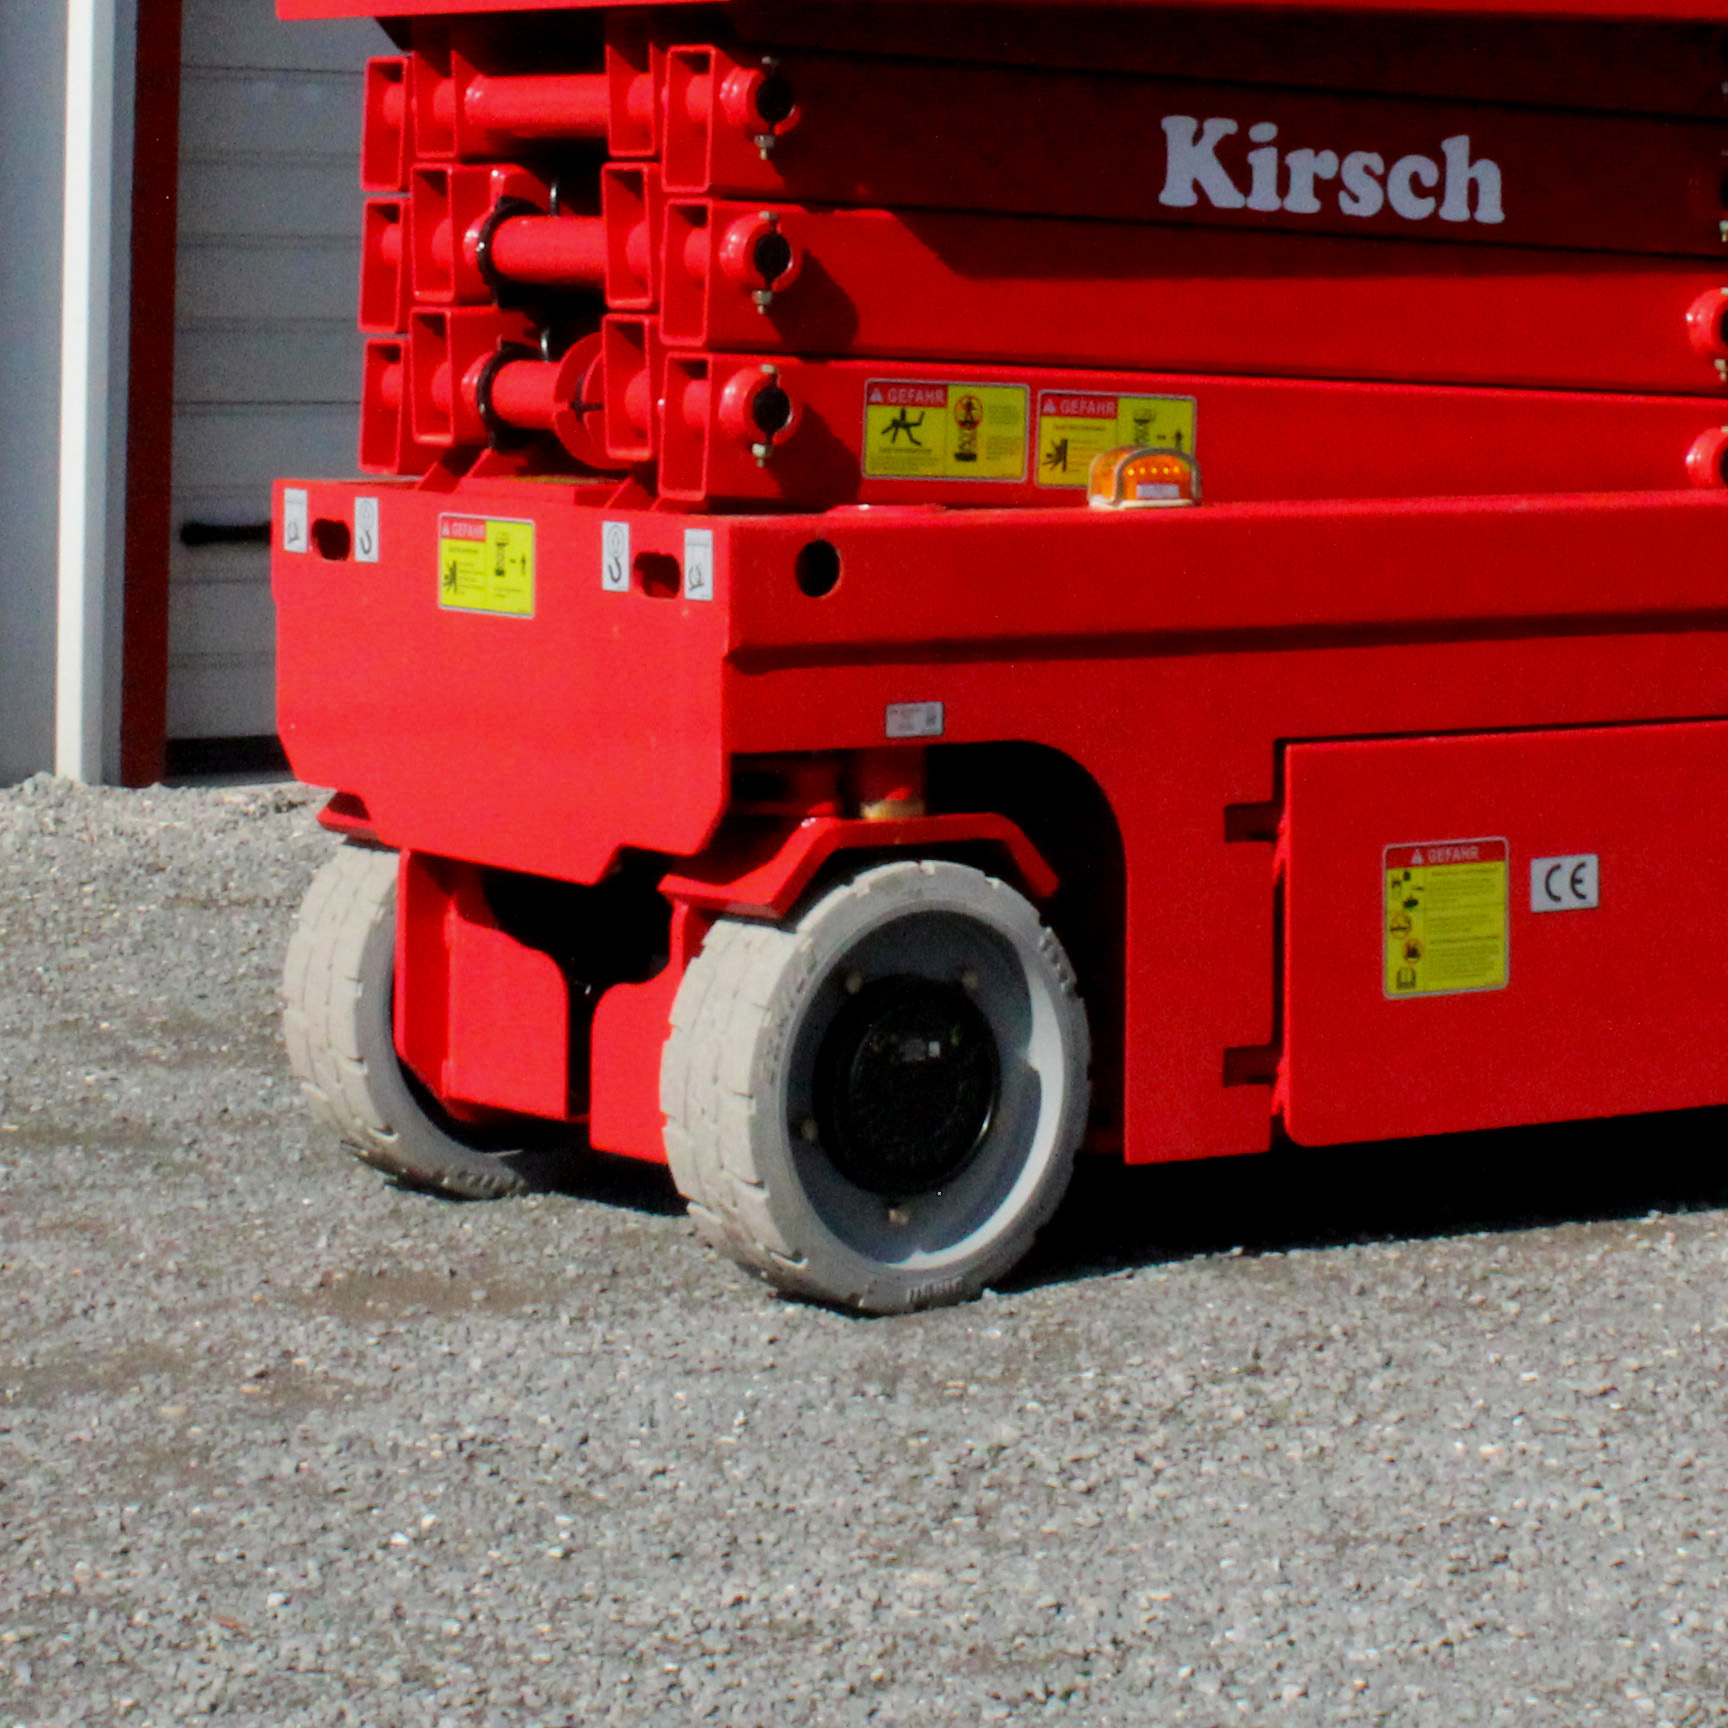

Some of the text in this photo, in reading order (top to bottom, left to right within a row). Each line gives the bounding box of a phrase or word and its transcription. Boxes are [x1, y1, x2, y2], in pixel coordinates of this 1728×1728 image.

[1158, 114, 1506, 224] Kirsch
[887, 387, 946, 404] GEFAHR
[1059, 398, 1117, 416] GEFAHR
[1427, 844, 1480, 864] GEFAHR
[1544, 860, 1588, 904] CE
